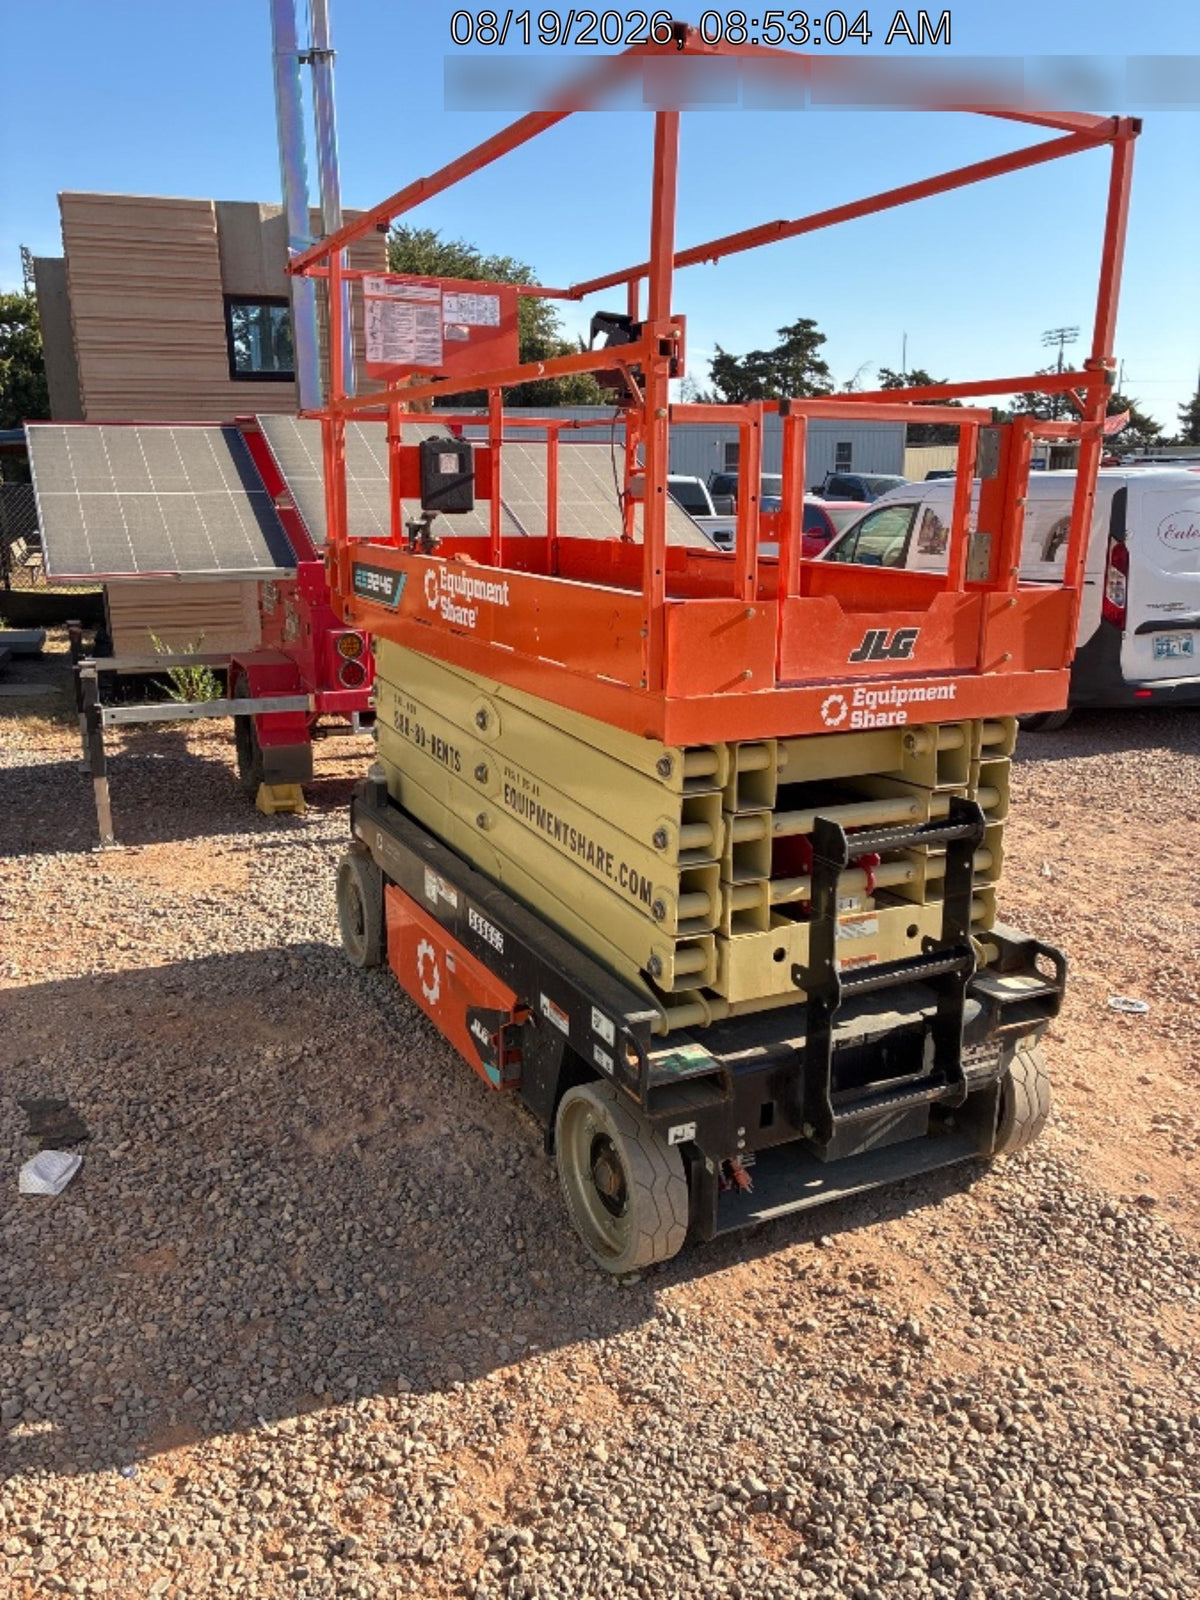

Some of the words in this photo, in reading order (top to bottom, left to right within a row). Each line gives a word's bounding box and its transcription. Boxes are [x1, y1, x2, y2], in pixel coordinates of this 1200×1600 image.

[439, 565, 510, 607] Equipment
[440, 596, 478, 629] Share
[847, 627, 921, 664] JLG
[851, 683, 957, 710] Equipment
[850, 709, 908, 729] Share
[504, 783, 653, 907] EQUIPMENTSHARE.COM
[470, 1018, 489, 1046] JLG
